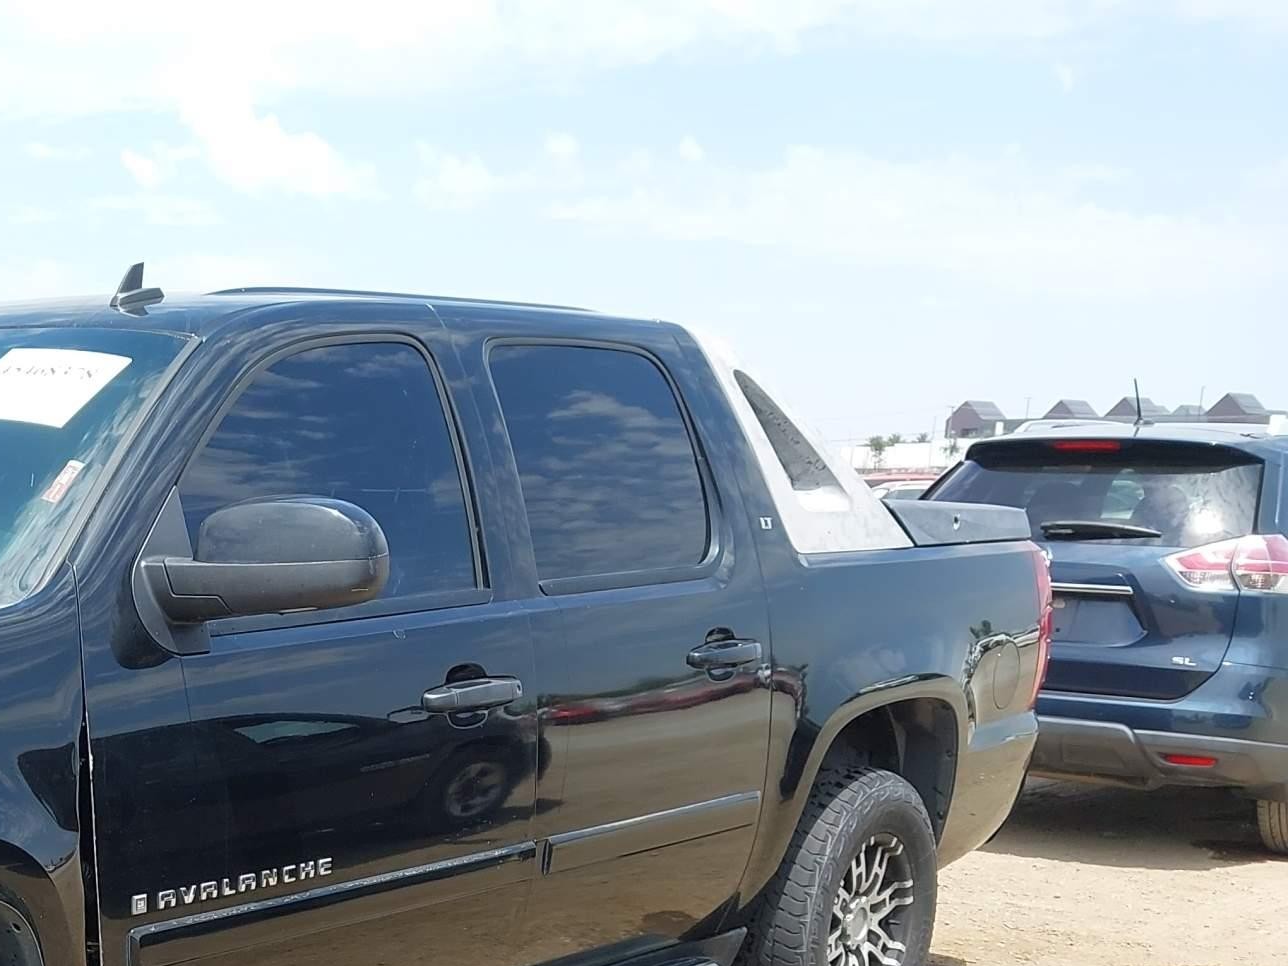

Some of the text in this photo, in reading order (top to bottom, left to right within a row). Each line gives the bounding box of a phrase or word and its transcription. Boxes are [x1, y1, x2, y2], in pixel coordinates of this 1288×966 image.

[759, 517, 773, 530] LT
[1171, 656, 1197, 666] SL
[157, 857, 333, 909] AVALANCHE
